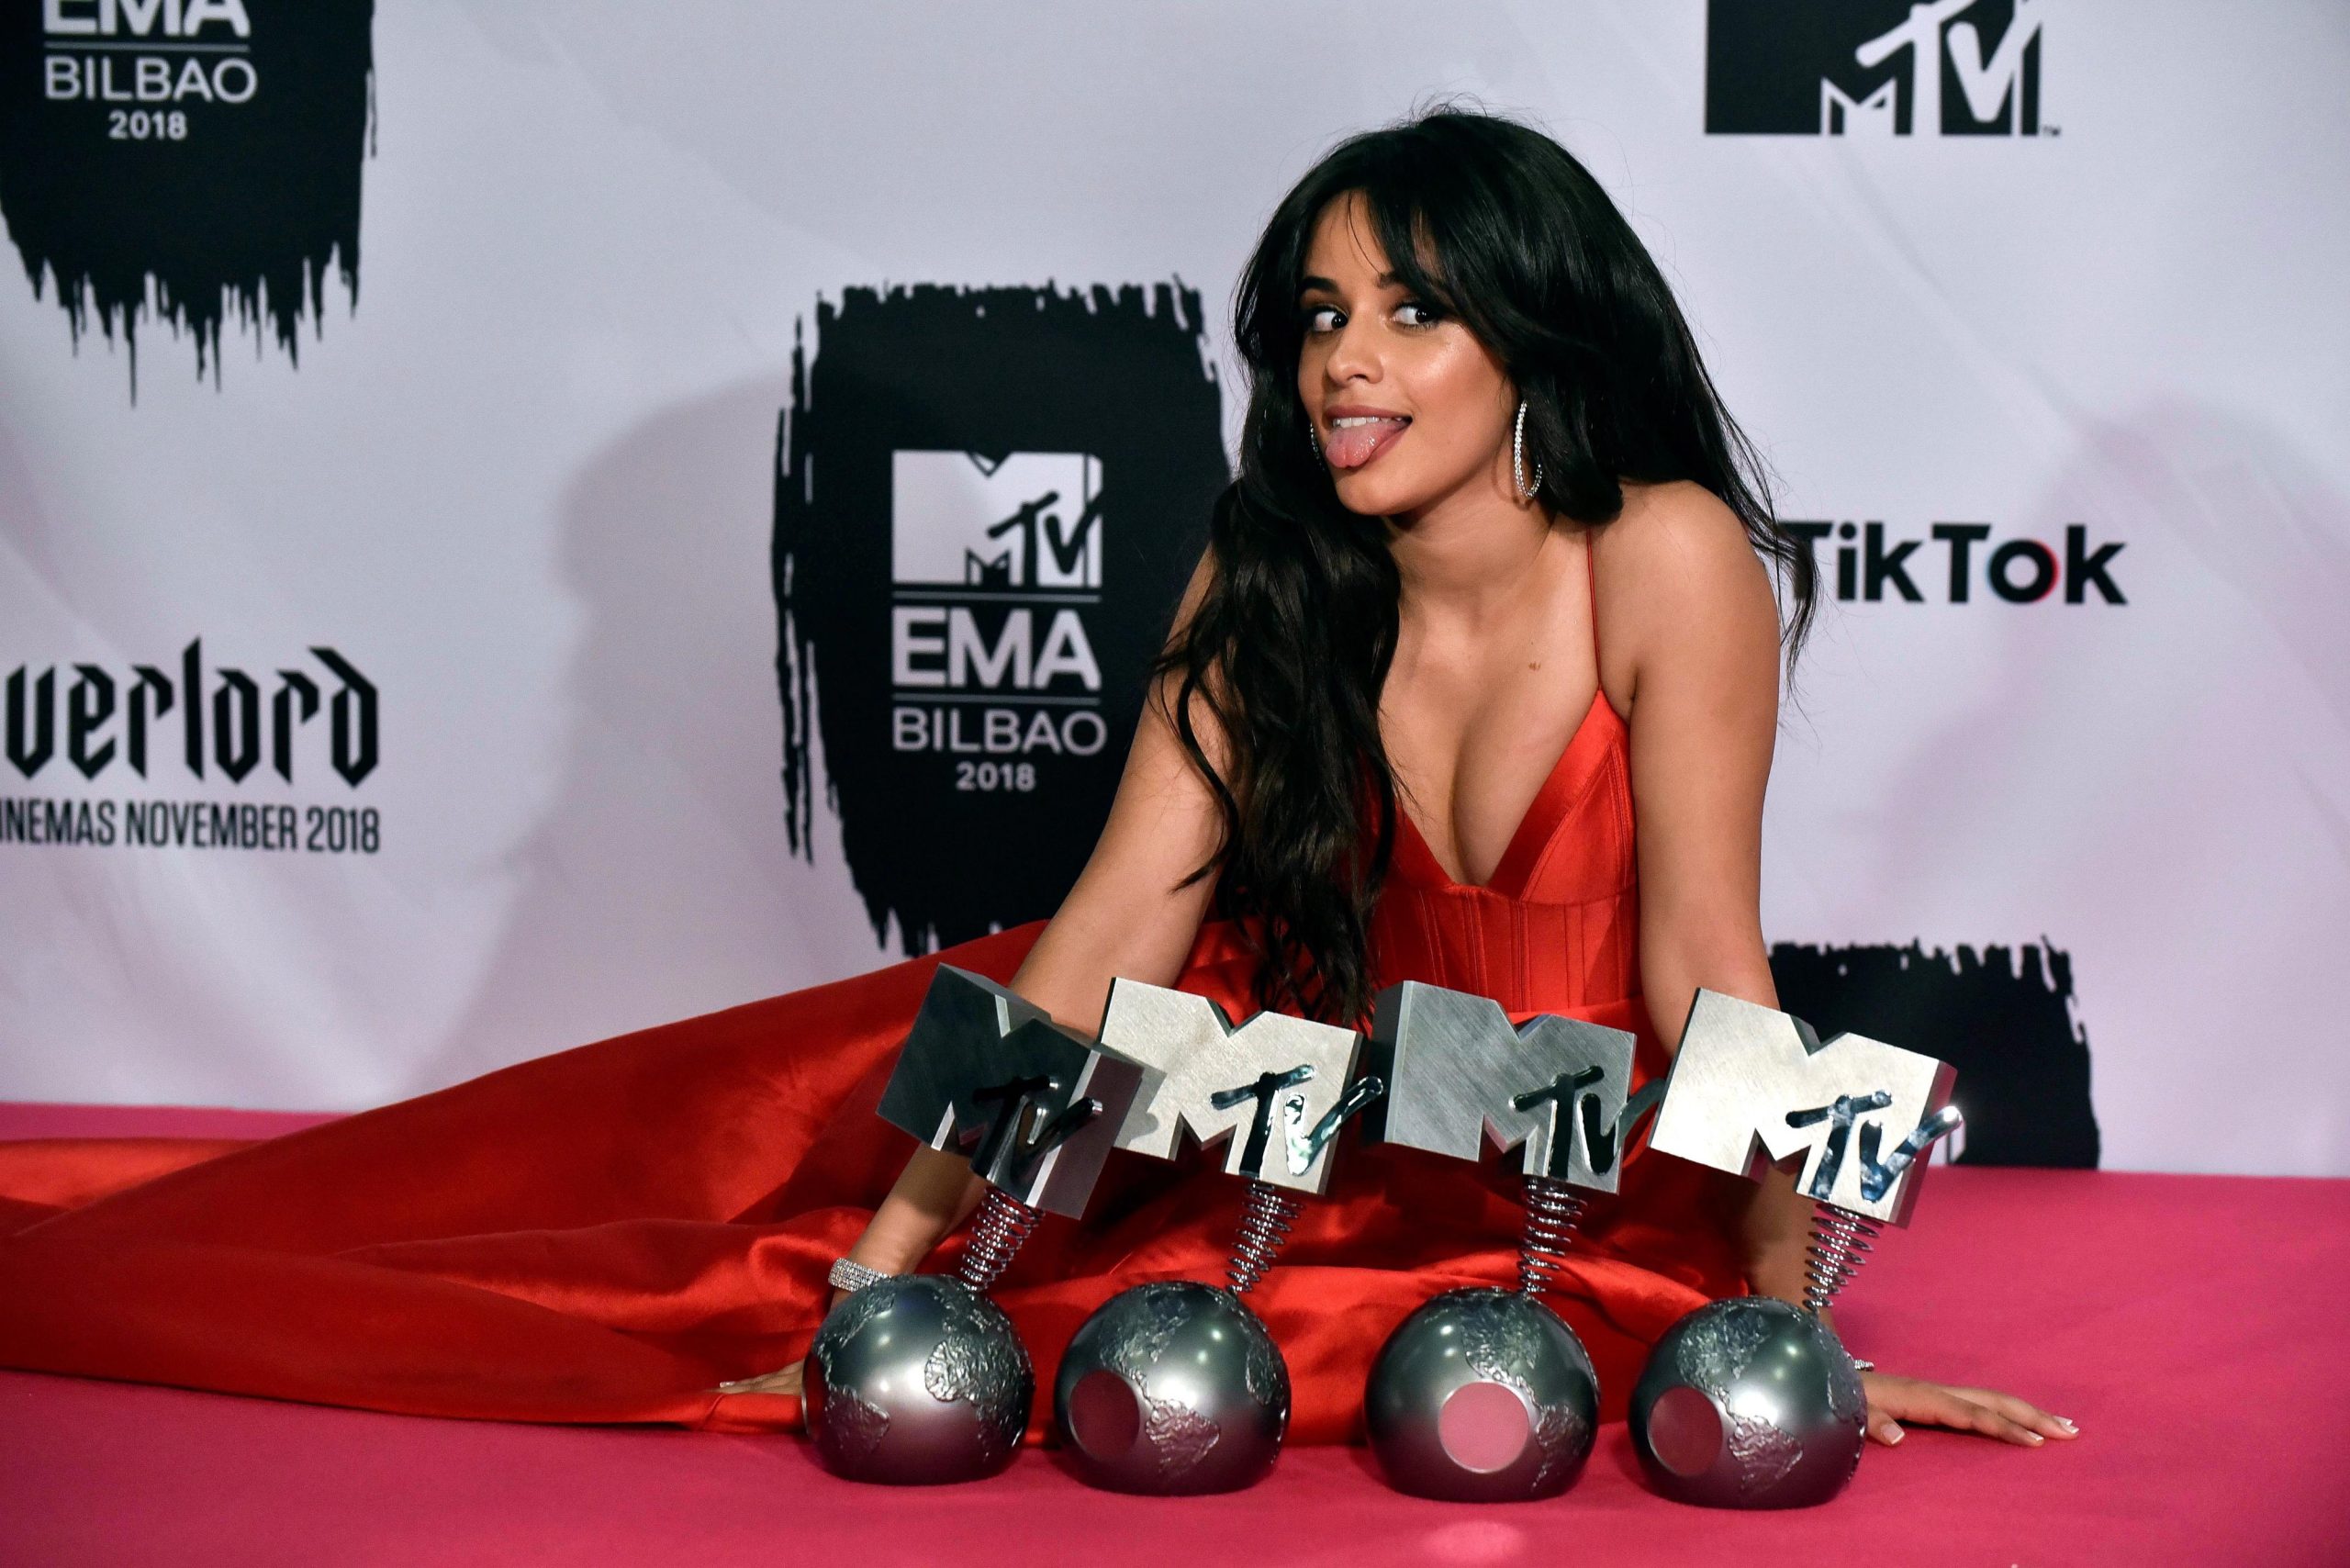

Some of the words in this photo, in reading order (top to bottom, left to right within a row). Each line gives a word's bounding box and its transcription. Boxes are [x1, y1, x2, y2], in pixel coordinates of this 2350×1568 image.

[44, 56, 258, 103] BILBAO
[1704, 0, 2042, 137] MTV
[108, 110, 187, 140] 2018
[892, 450, 1102, 588] MTV
[1775, 521, 2127, 606] TikTok
[892, 606, 1102, 690] EMA
[5, 636, 379, 790] verlord
[892, 707, 1107, 756] BILBAO
[125, 800, 299, 851] NOVEMBER
[306, 805, 380, 855] 2018
[956, 761, 1035, 791] 2018
[876, 963, 1104, 1208] MTV
[1102, 977, 1384, 1193] MTV
[1384, 980, 1666, 1195] MTV
[1650, 987, 1964, 1223] MTV
